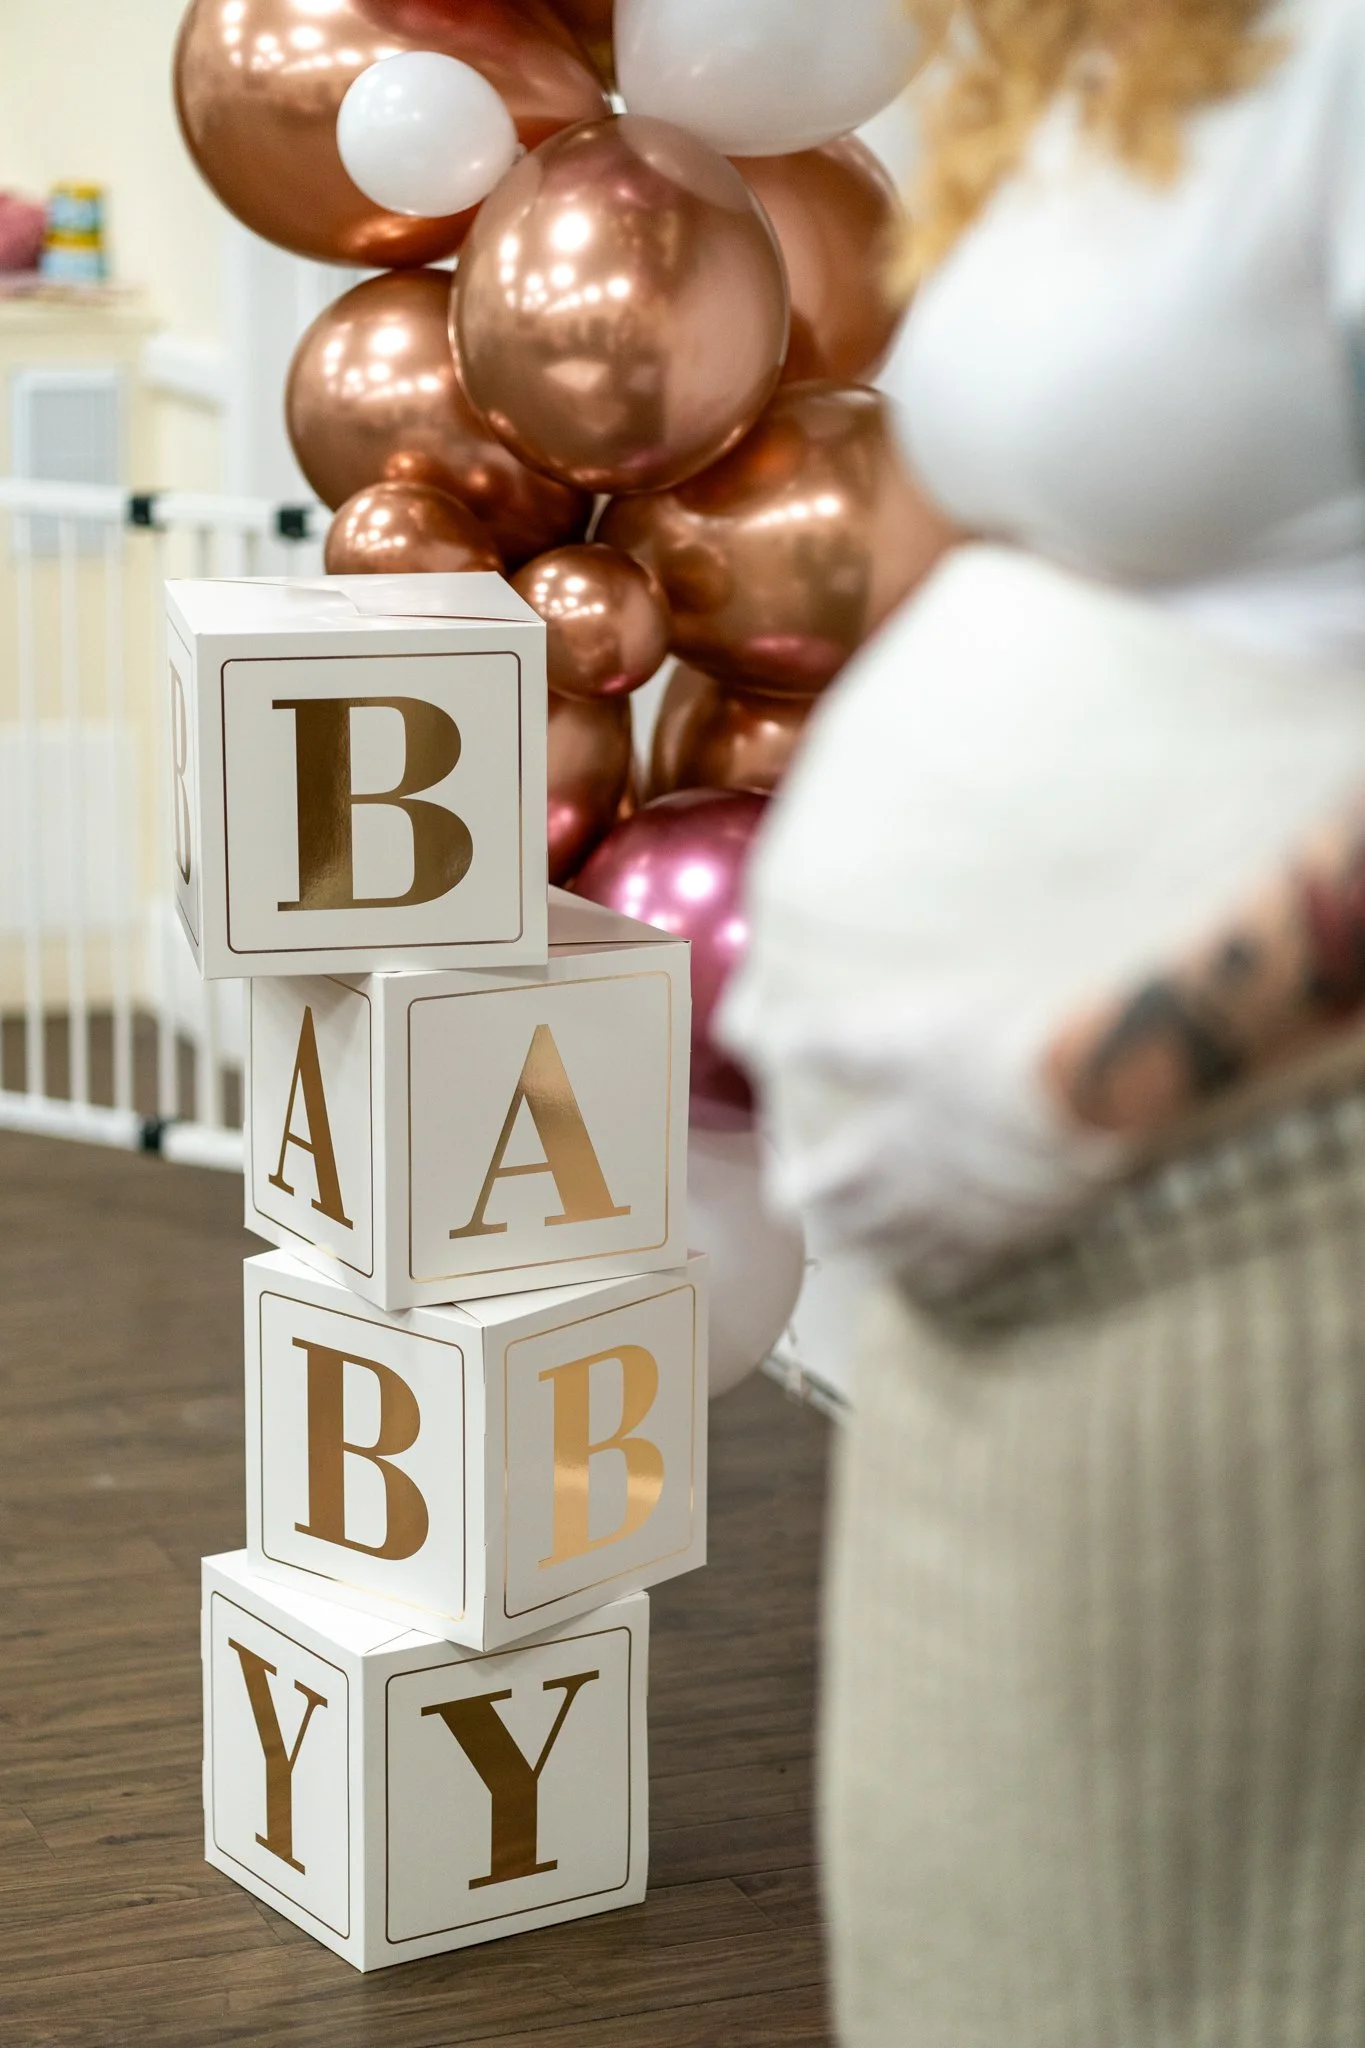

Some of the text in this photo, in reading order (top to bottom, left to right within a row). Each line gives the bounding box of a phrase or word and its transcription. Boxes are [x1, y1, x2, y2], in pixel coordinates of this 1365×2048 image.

[272, 695, 474, 912] B
[268, 1005, 354, 1230] A
[449, 1023, 632, 1239] A
[292, 1336, 430, 1562] B
[538, 1344, 665, 1570] B
[228, 1637, 328, 1876] Y
[421, 1670, 600, 1891] Y
